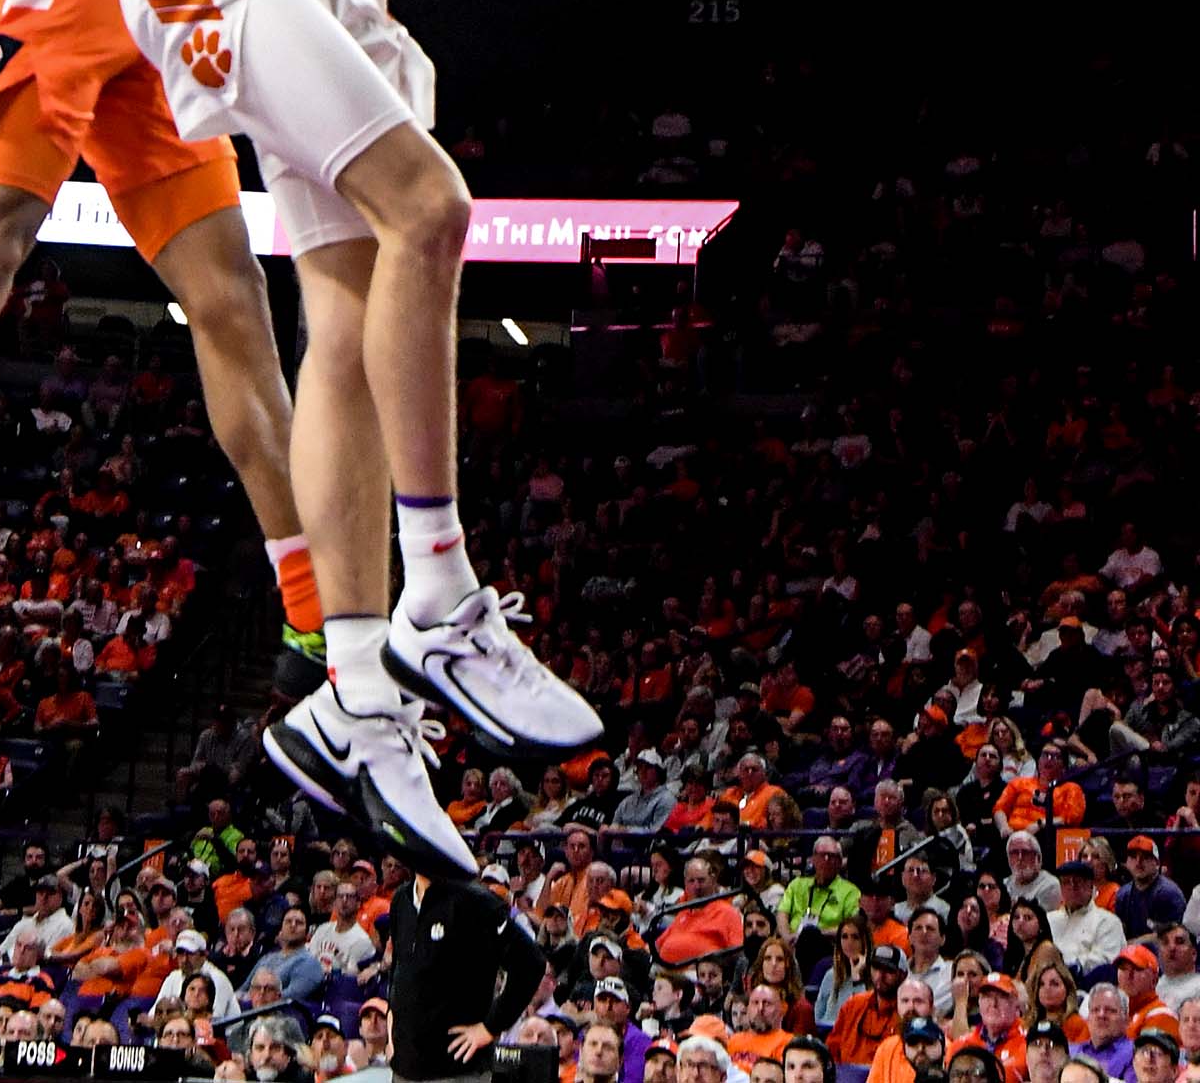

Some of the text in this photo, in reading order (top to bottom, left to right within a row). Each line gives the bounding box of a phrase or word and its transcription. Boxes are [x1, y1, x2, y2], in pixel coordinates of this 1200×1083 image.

[689, 0, 740, 23] 215
[17, 1041, 56, 1066] POSS
[109, 1046, 145, 1072] BONUS
